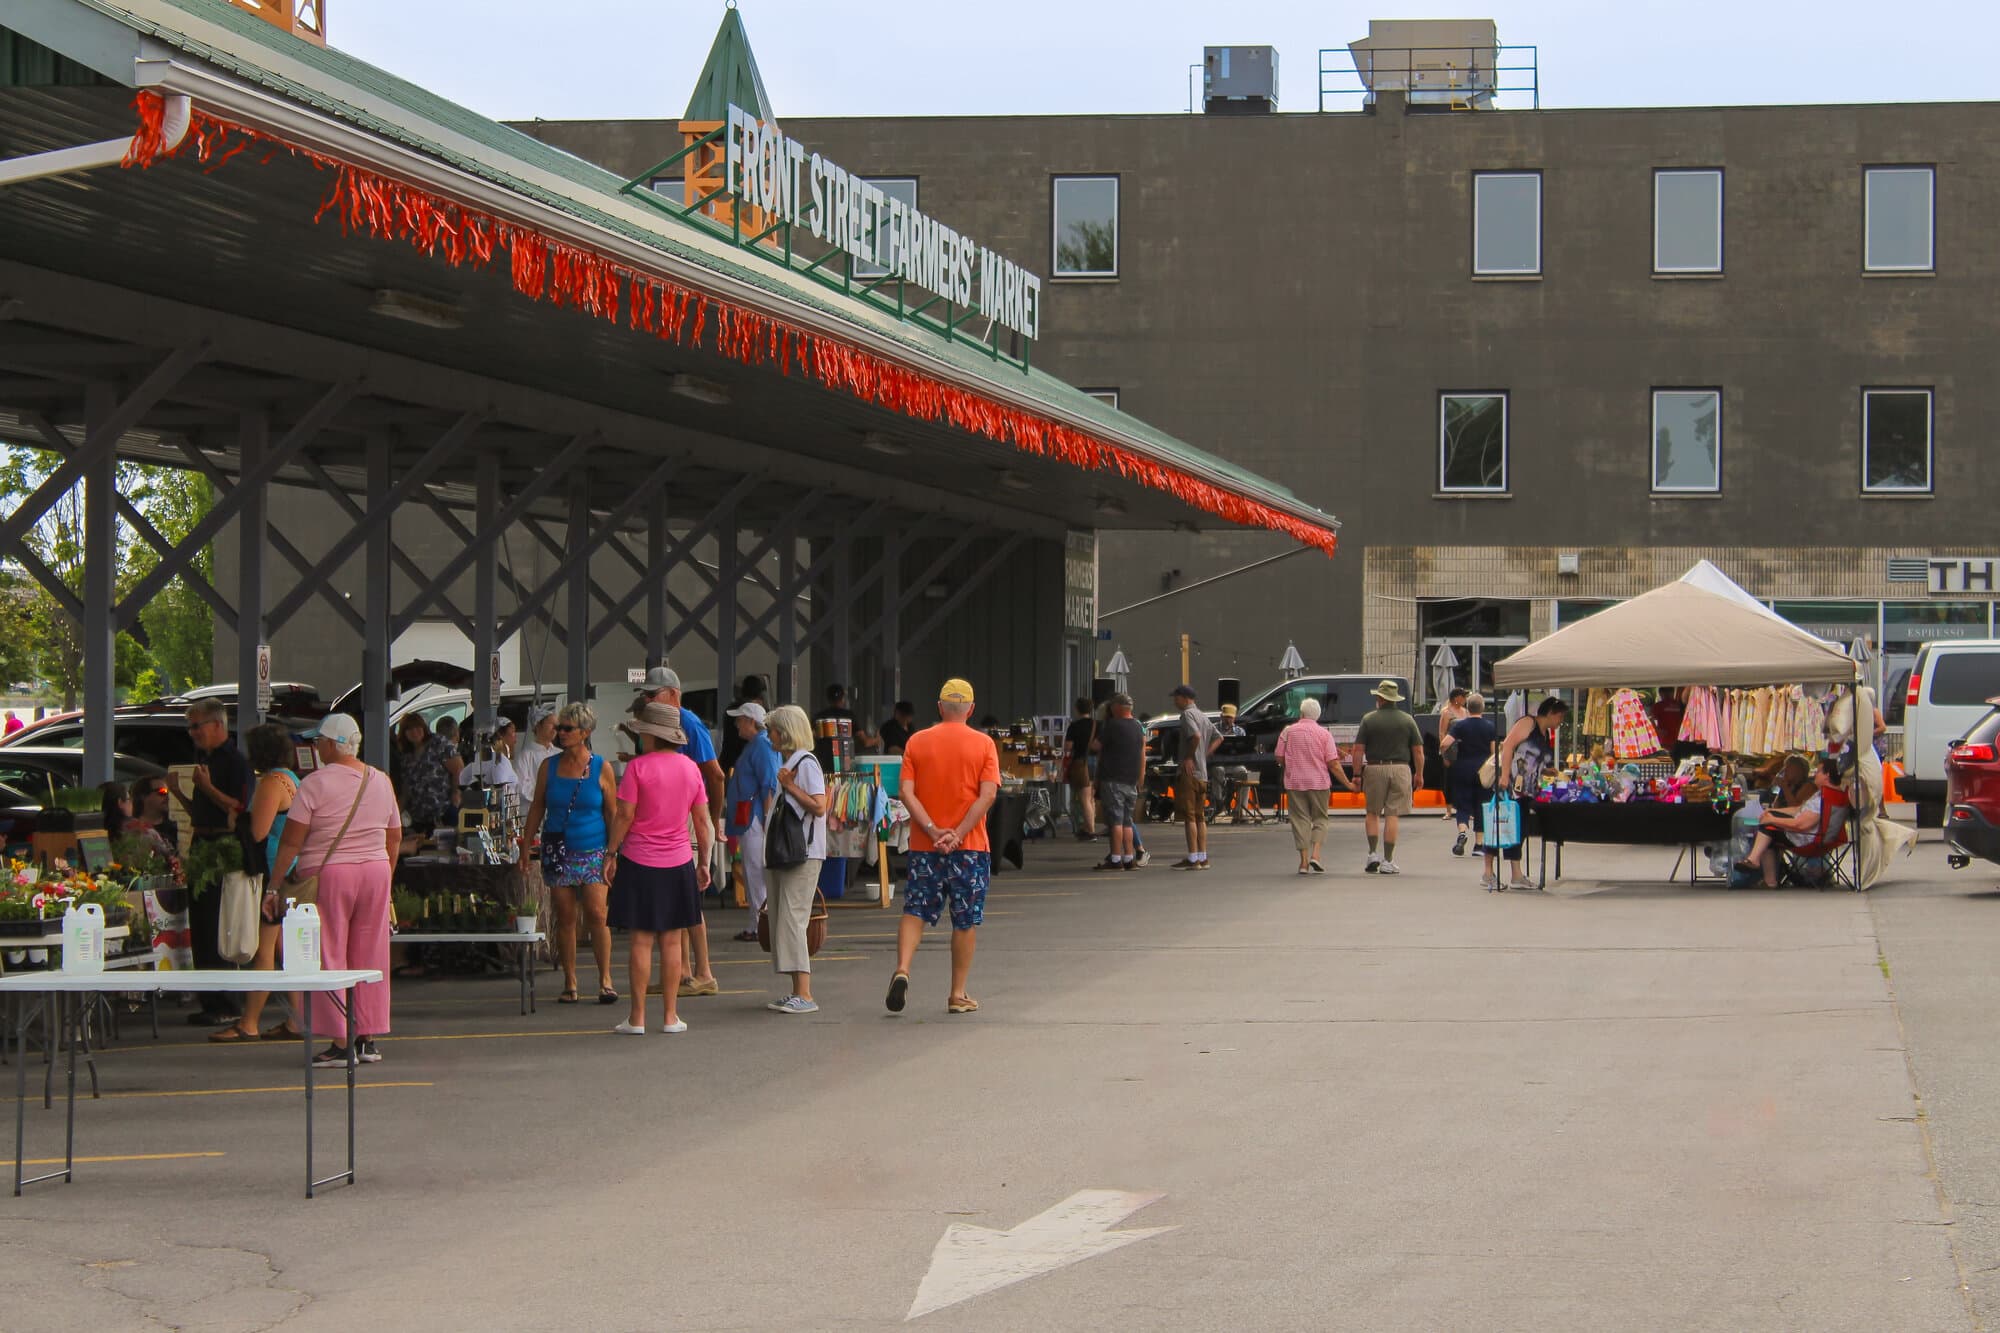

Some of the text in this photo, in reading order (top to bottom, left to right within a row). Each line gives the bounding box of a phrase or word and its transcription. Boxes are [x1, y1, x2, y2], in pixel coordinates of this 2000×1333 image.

[728, 102, 1041, 341] FRONT STREET FARMERS' MARKET
[1065, 594, 1093, 629] MARKET
[1907, 627, 1965, 637] ESPRESSO
